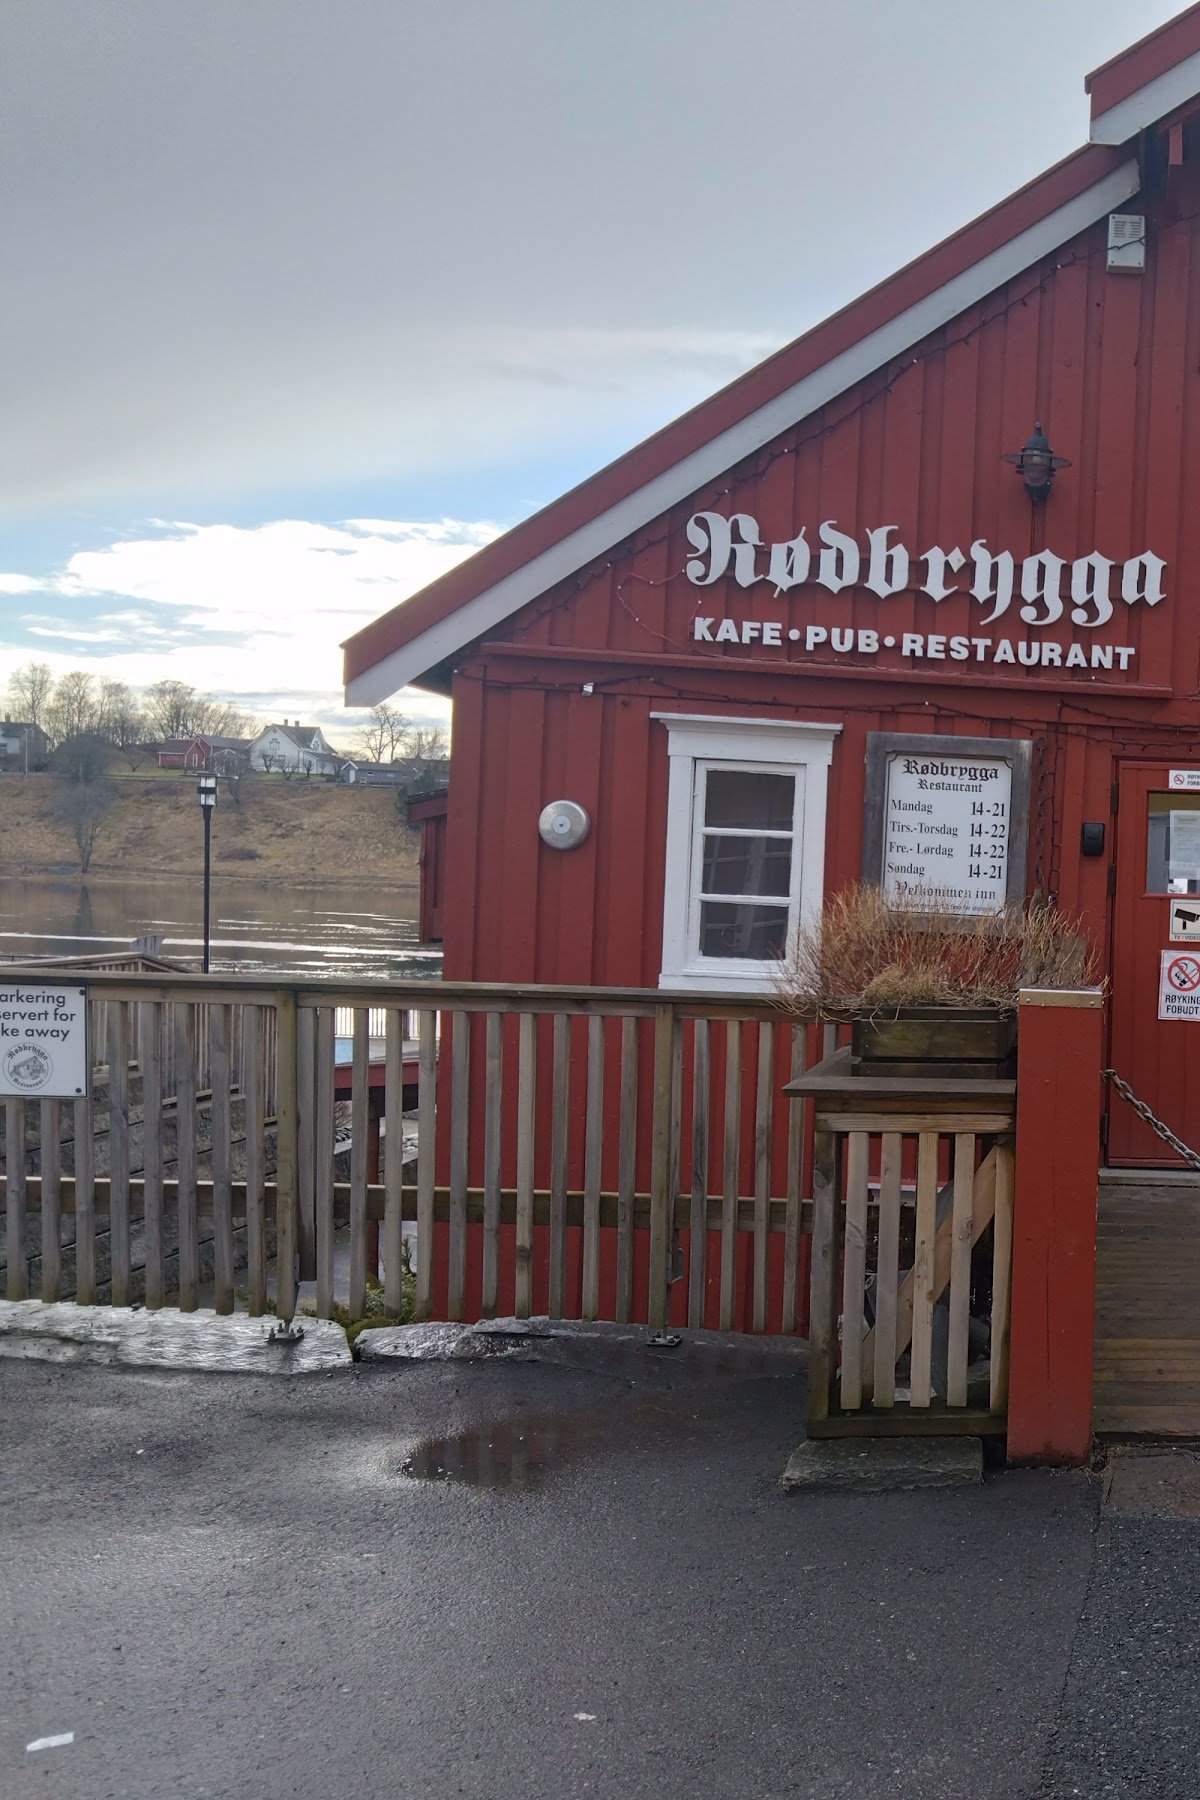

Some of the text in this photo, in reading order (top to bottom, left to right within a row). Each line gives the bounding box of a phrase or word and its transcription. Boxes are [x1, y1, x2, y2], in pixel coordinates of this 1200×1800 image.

[685, 511, 1168, 628] Rødbrygga
[901, 632, 1137, 671] RESTAURANT
[902, 758, 1000, 782] Rødbrygga
[917, 778, 984, 793] Restaurant
[890, 799, 933, 815] Mandag
[887, 862, 925, 877] Søndag
[975, 888, 996, 900] inn
[0, 1007, 76, 1022] ervert for
[1166, 1004, 1199, 1015] FOBUDT
[24, 1028, 70, 1042] away
